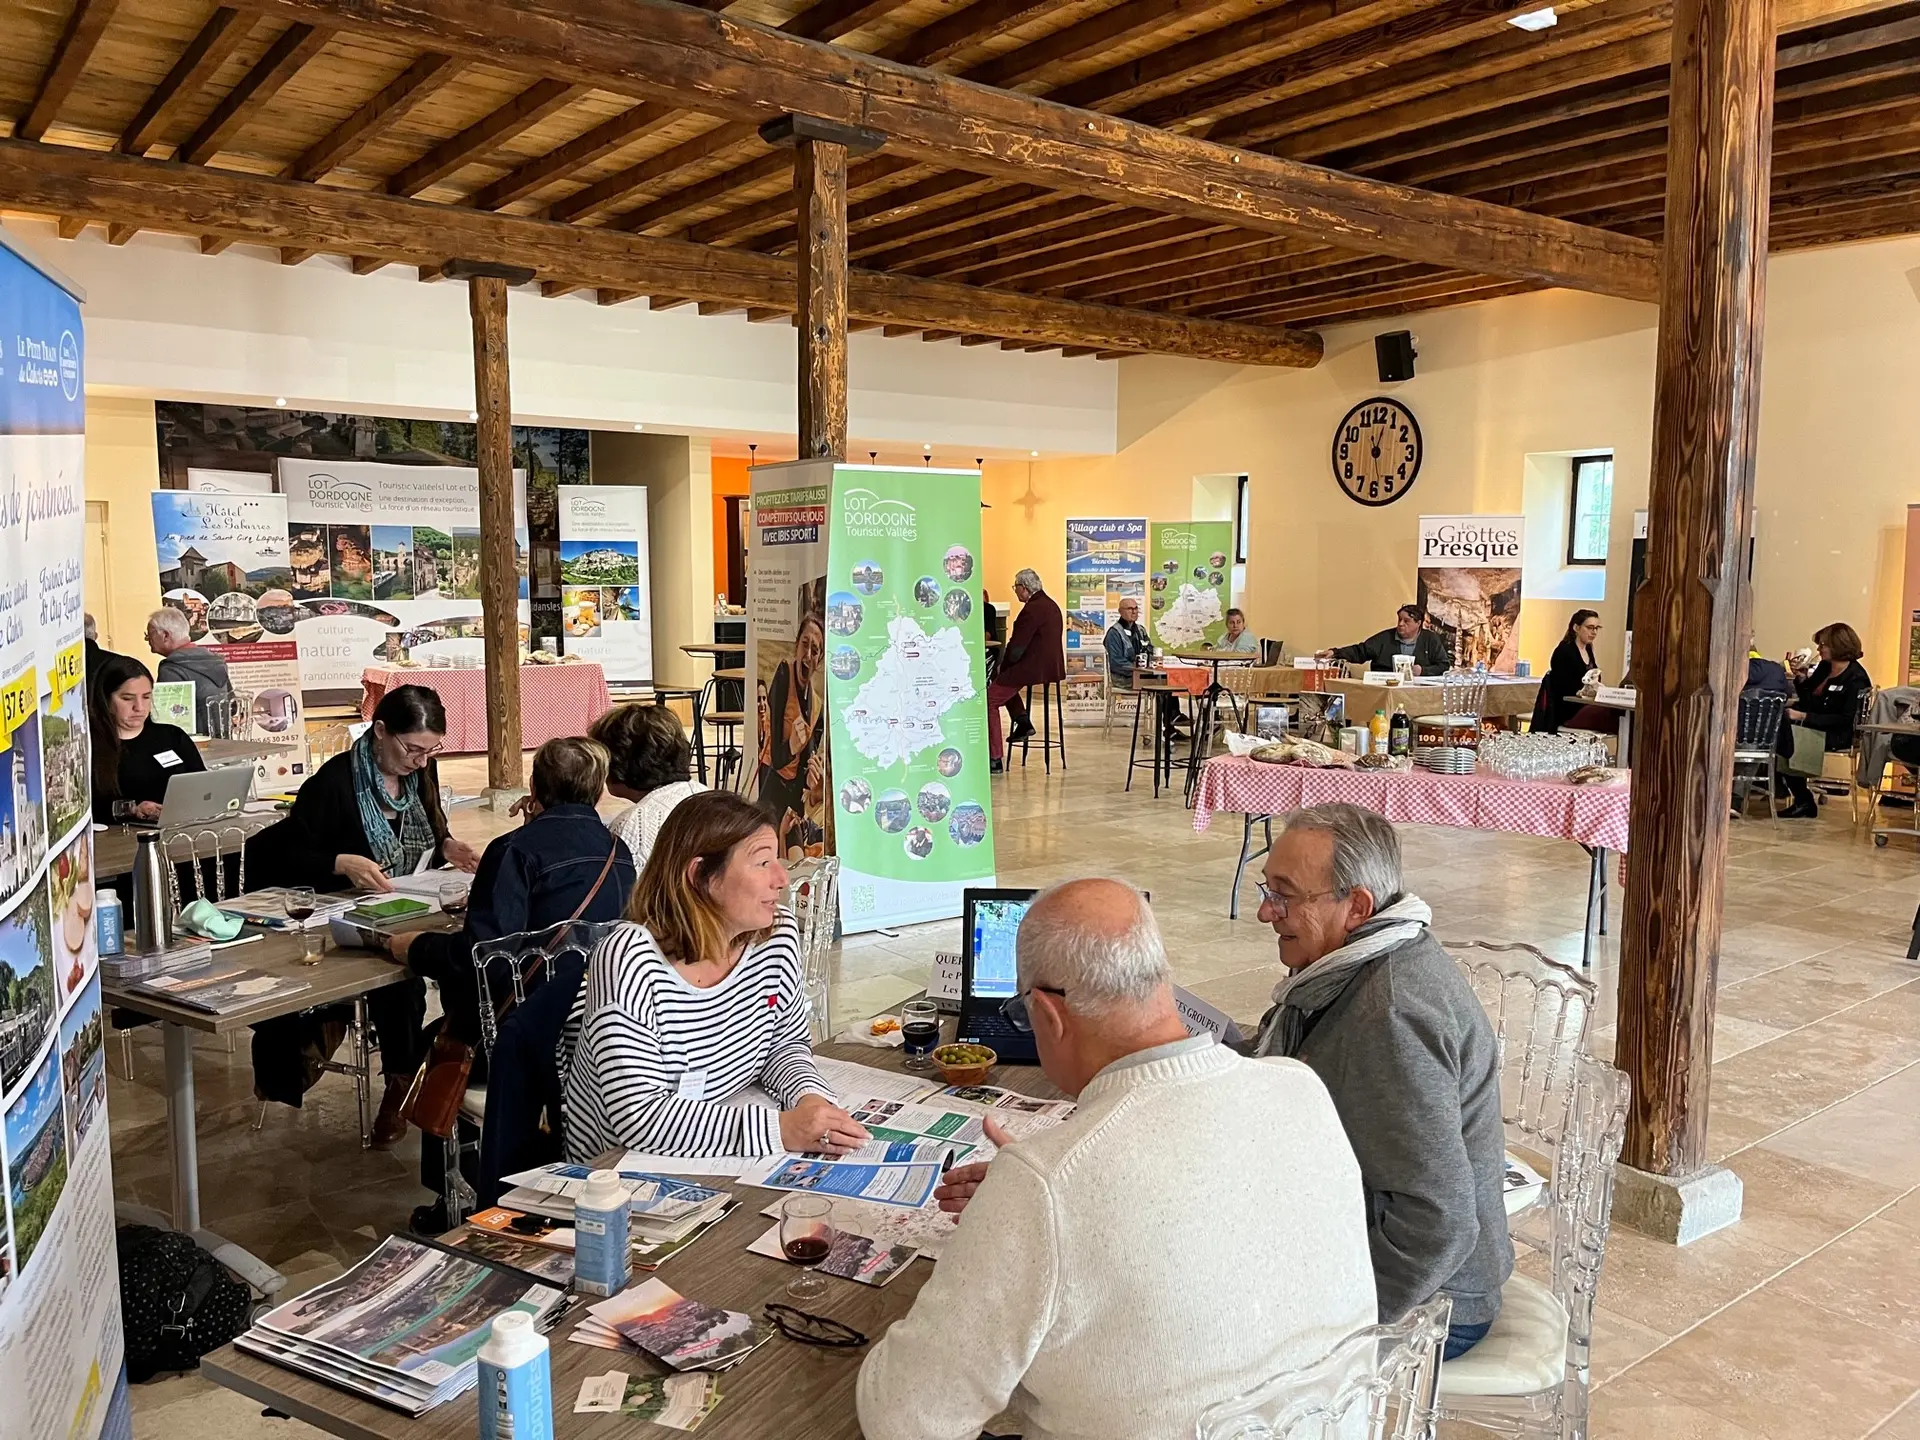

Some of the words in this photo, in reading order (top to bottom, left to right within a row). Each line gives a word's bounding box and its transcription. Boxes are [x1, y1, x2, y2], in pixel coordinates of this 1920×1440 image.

[1360, 410, 1371, 428] 11
[1373, 407, 1388, 425] 12
[1390, 411, 1397, 429] 1
[1345, 425, 1359, 443] 10
[1399, 425, 1408, 443] 2
[1340, 443, 1349, 460] 9
[1405, 444, 1414, 462] 3
[1344, 462, 1353, 479] 8
[1397, 462, 1406, 480] 4
[308, 480, 329, 490] LOT
[378, 480, 411, 490] Touristic
[446, 483, 457, 491] Lot
[468, 484, 479, 492] Do
[1356, 475, 1365, 492] 7
[1370, 480, 1379, 498] 6
[1384, 475, 1394, 493] 5
[308, 490, 373, 502] DORDOGNE
[393, 495, 429, 503] destination
[756, 493, 781, 506] PROFITEZ
[781, 493, 790, 503] DE
[790, 490, 809, 503] TARIFS
[809, 488, 827, 501] AUSSI
[205, 502, 242, 517] Hôtel
[311, 500, 344, 509] Touristic
[346, 501, 373, 511] Vallées
[442, 505, 475, 513] touristique
[843, 497, 868, 511] LOT
[793, 511, 807, 523] QUE
[807, 510, 824, 522] VOUS
[844, 511, 917, 526] DORDOGNE
[845, 526, 884, 537] Touristic
[885, 527, 917, 539] Vallées
[1068, 522, 1098, 534] Village
[1099, 523, 1116, 532] club
[1117, 523, 1125, 532] et
[1126, 522, 1143, 534] Spa
[1461, 522, 1475, 530] Les
[179, 534, 196, 543] pied
[211, 532, 233, 541] Saint
[236, 533, 253, 544] Cirq
[763, 531, 777, 543] AVEC
[777, 530, 790, 542] IBIS
[790, 528, 812, 541] SPORT
[1424, 530, 1435, 538] de
[1438, 525, 1517, 544] Grottes
[1423, 538, 1519, 562] Presque
[317, 626, 354, 635] culture
[300, 645, 351, 657] nature
[303, 671, 362, 681] randonnées
[5, 690, 16, 721] 37
[1418, 734, 1436, 742] 100
[942, 969, 953, 979] Le
[955, 971, 963, 980] P
[943, 984, 958, 994] Les
[1186, 1007, 1220, 1034] GROUPES
